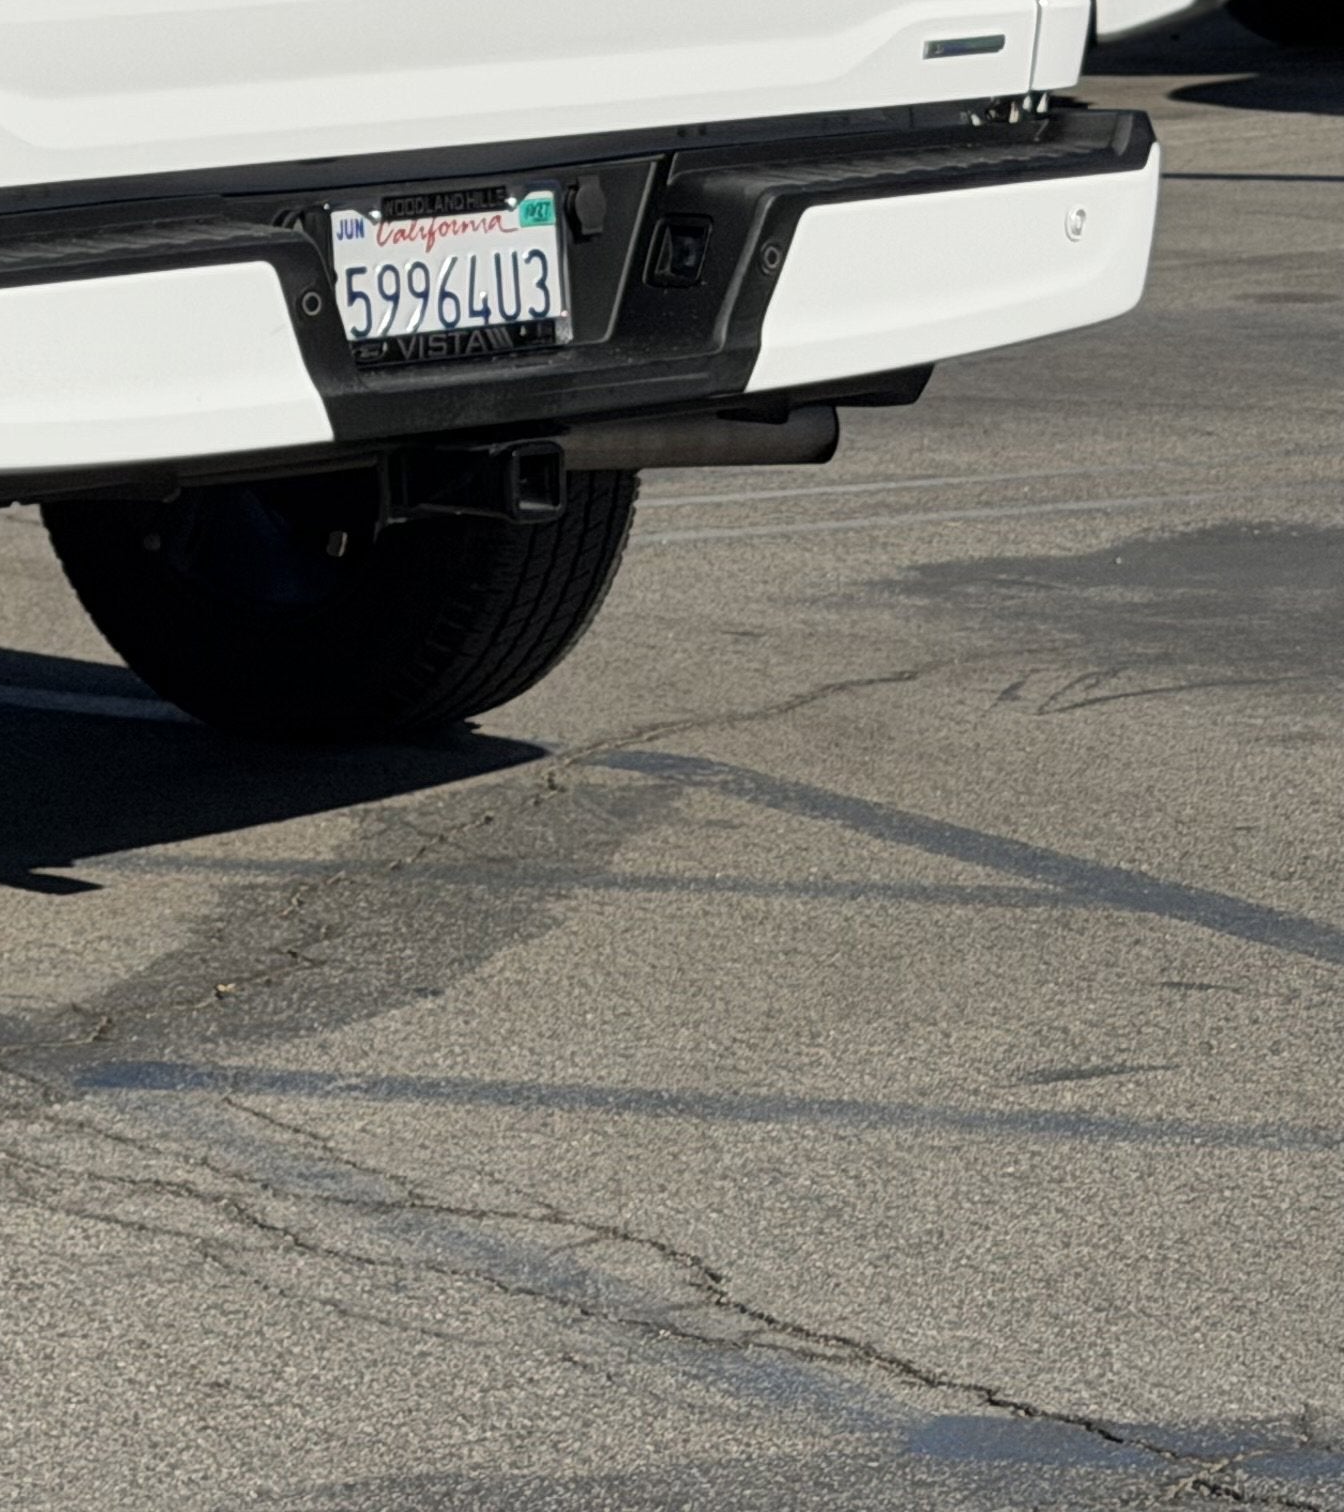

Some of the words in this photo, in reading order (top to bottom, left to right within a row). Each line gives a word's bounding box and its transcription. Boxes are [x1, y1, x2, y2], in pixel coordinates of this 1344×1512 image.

[384, 192, 465, 217] WOODLAND
[336, 219, 365, 241] JUN
[376, 214, 518, 253] California
[345, 249, 551, 338] 59964U3
[397, 330, 489, 361] VISTA
